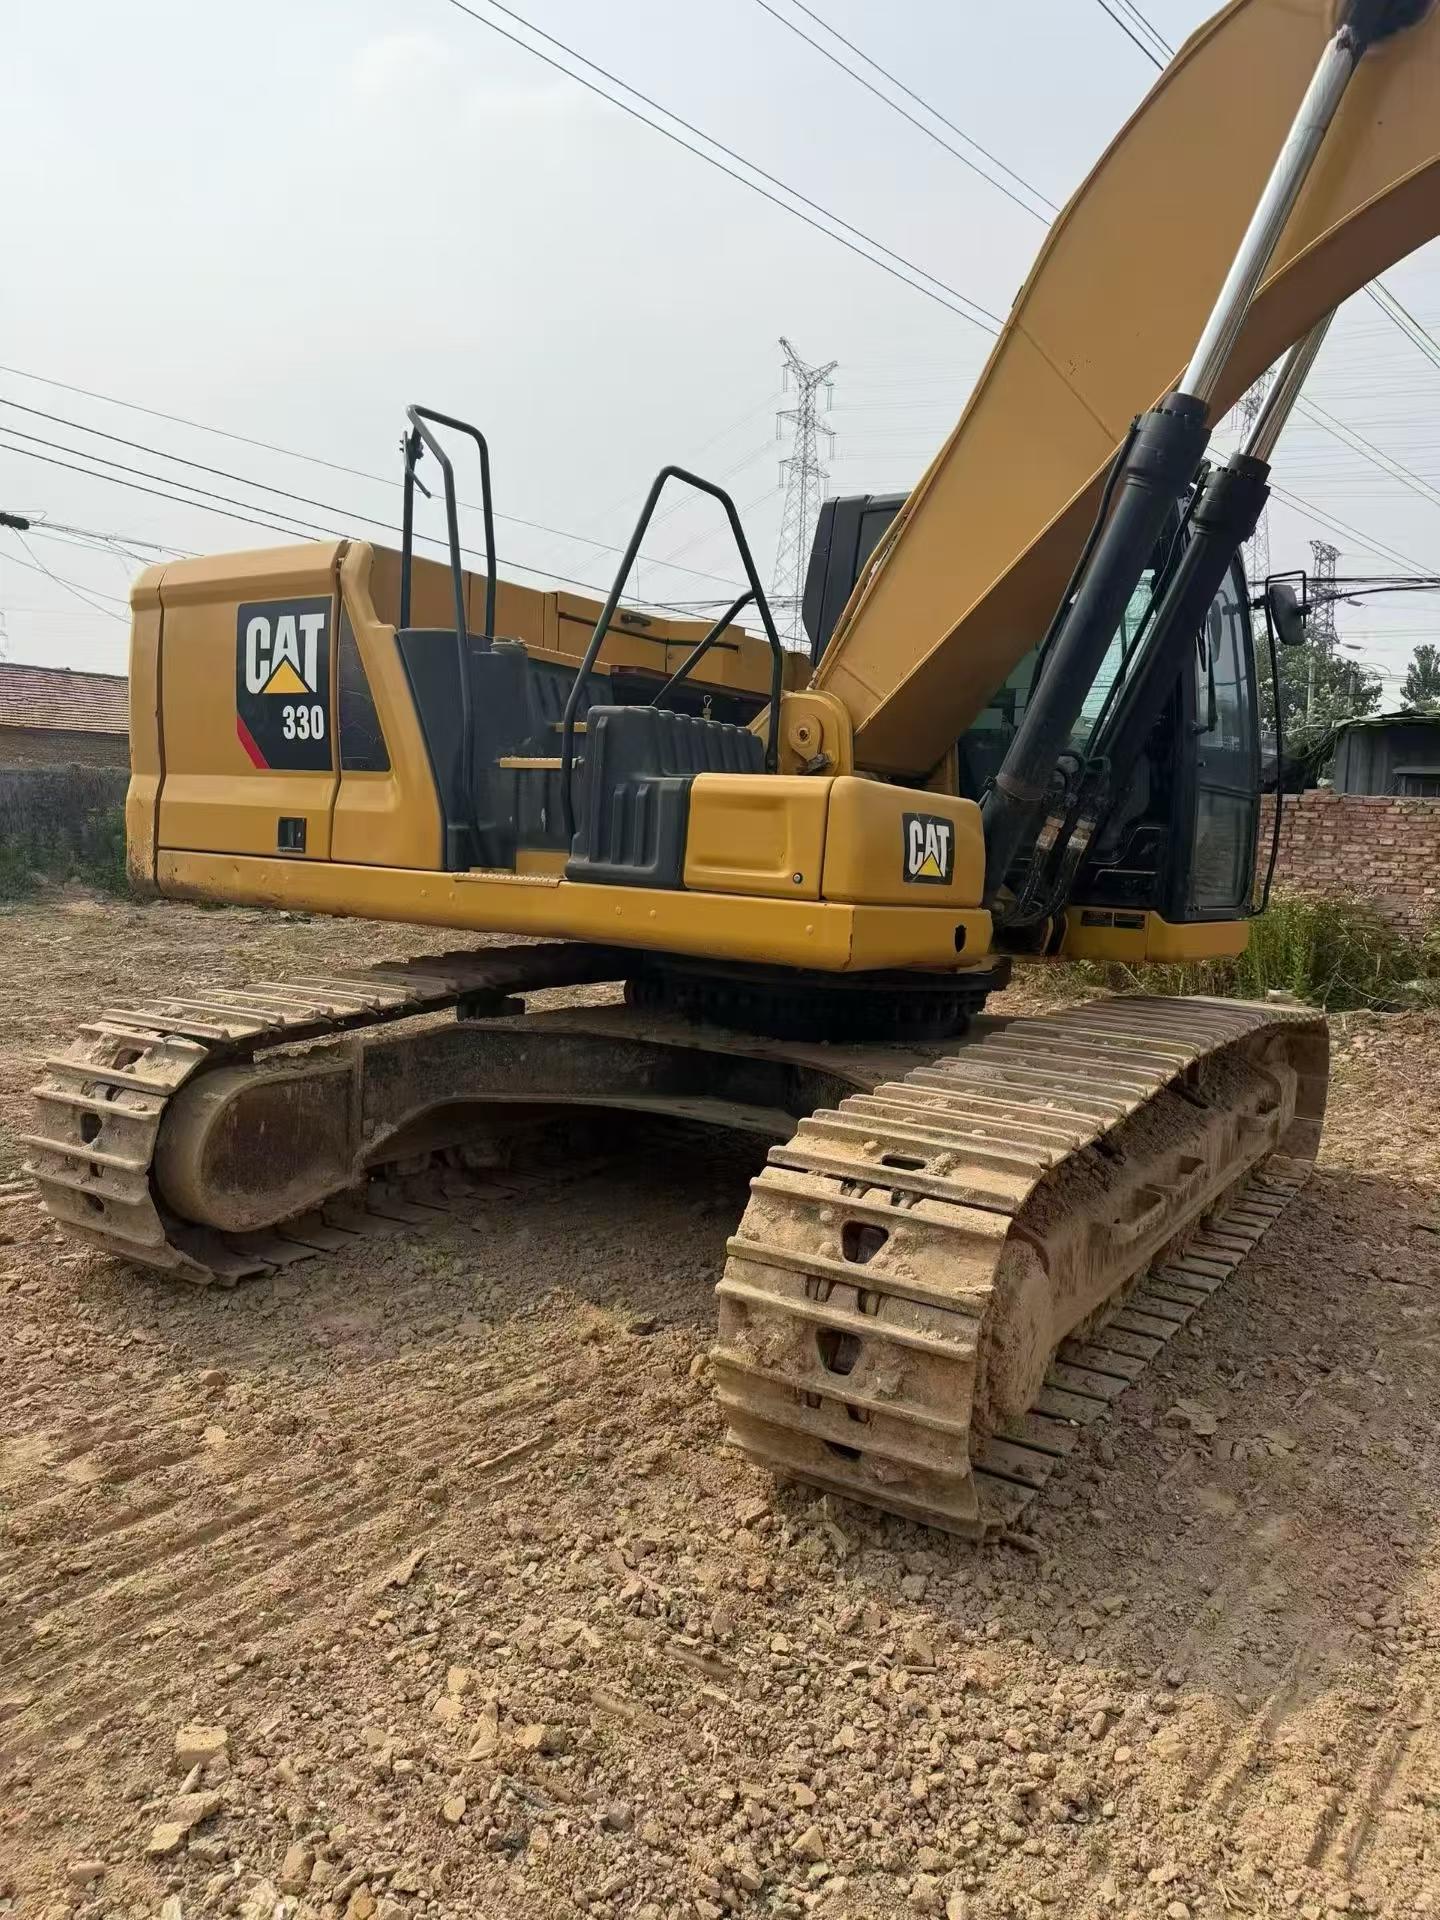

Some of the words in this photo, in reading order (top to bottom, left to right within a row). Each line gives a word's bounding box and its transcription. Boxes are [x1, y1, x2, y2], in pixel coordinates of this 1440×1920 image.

[246, 613, 325, 694] CAT
[282, 705, 324, 740] 330
[909, 820, 949, 877] CAT
